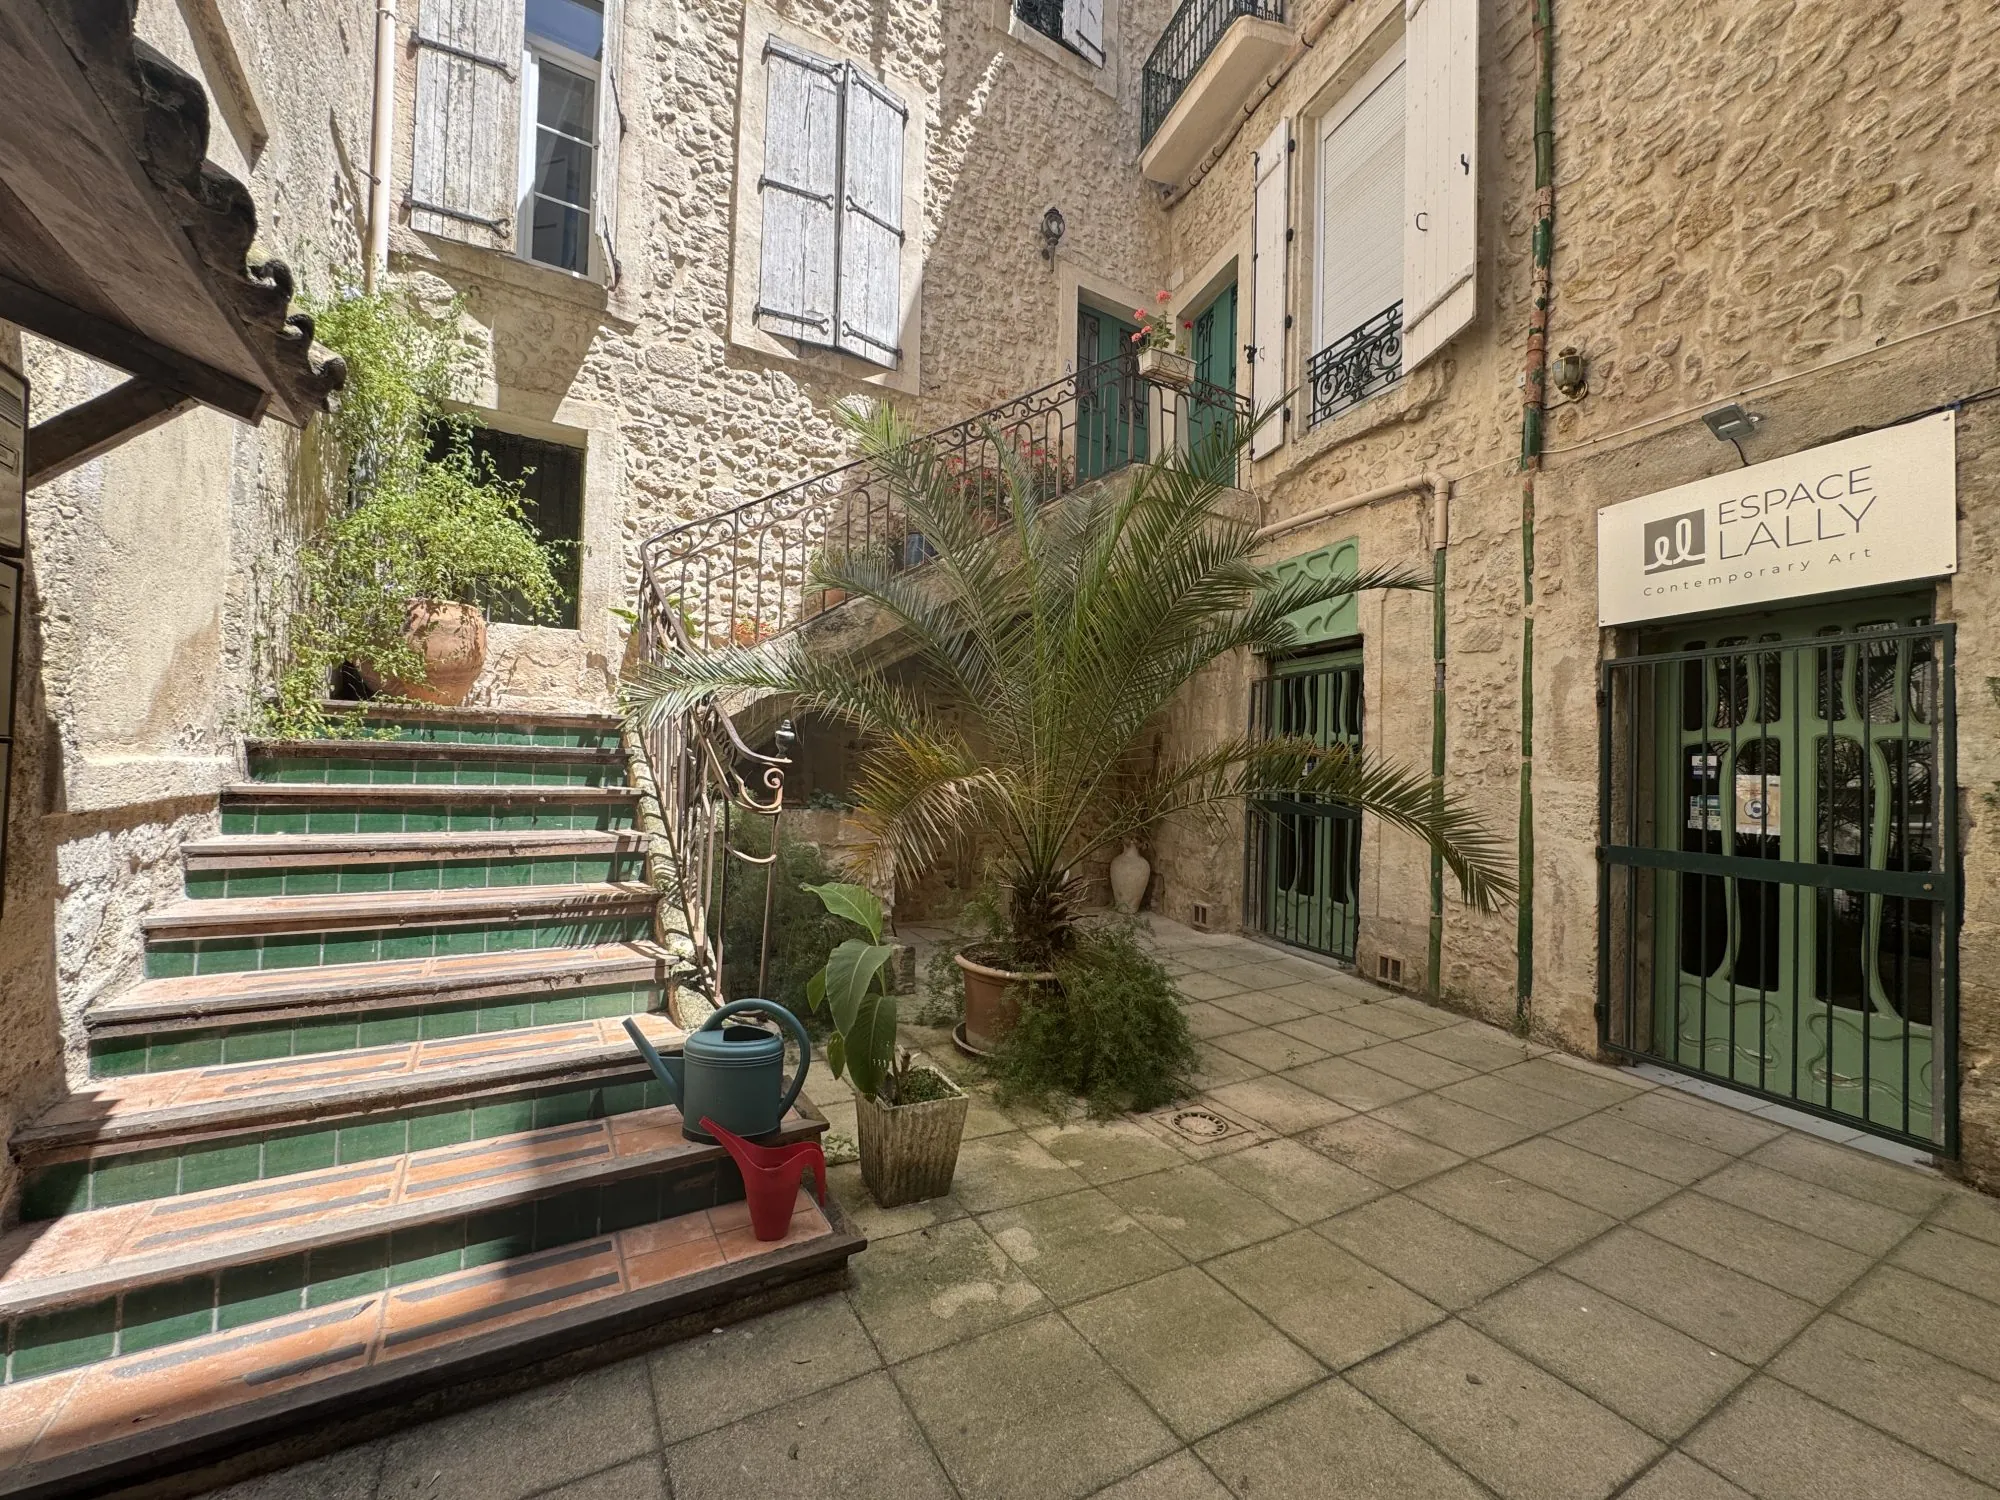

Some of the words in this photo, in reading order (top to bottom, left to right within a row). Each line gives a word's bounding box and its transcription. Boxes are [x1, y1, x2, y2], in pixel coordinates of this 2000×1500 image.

[1718, 465, 1873, 525] ESPACE
[1719, 495, 1878, 561] LALLY
[1642, 559, 1811, 597] Contemporary
[1827, 548, 1873, 565] Art
